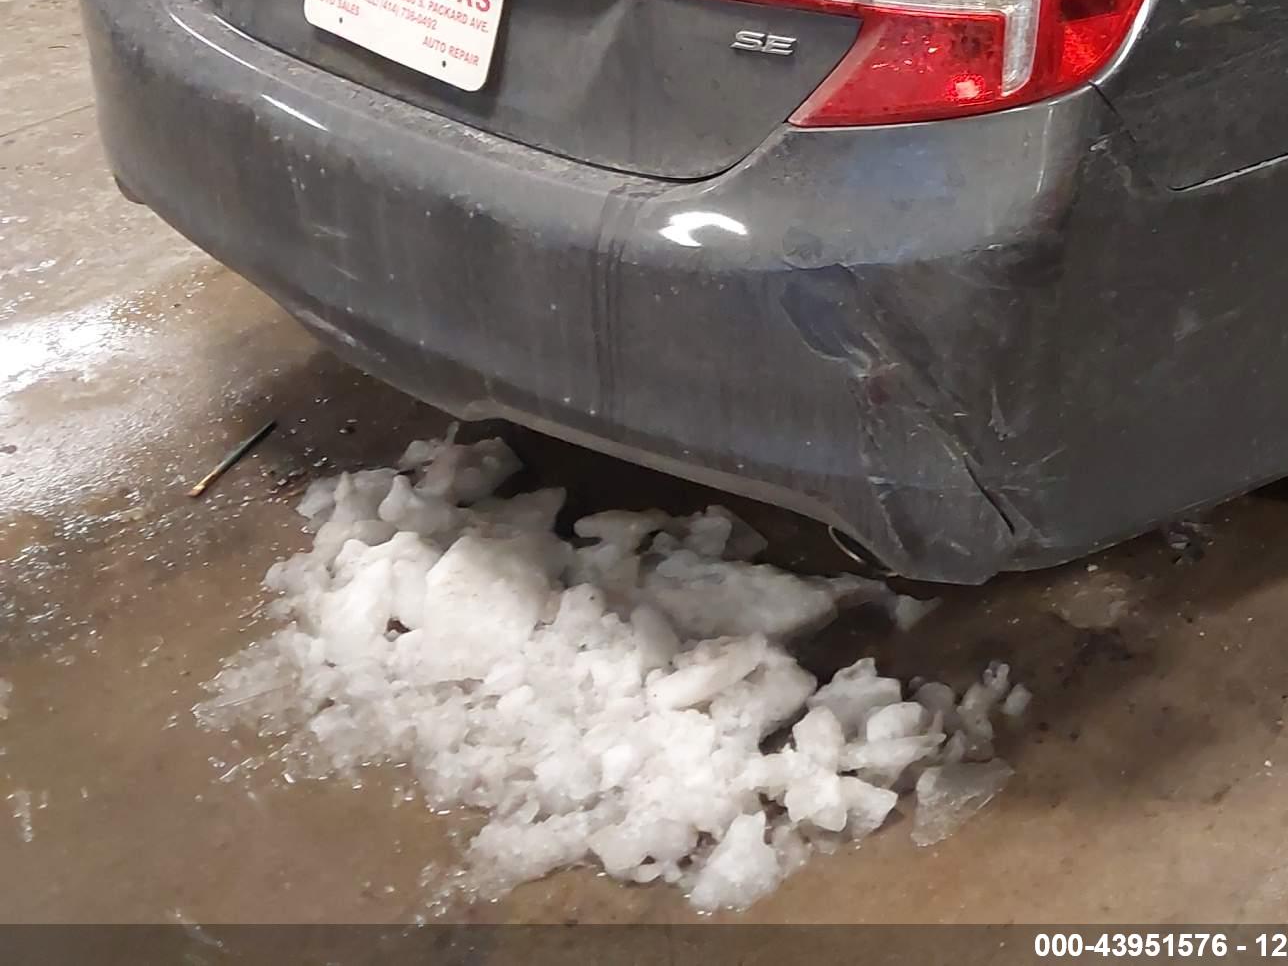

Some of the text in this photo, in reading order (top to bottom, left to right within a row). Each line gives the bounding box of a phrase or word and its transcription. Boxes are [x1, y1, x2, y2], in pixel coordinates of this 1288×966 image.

[428, 0, 469, 26] PACKARD
[470, 16, 489, 34] AVE.
[422, 35, 480, 67] AUTO REPAIR
[729, 30, 797, 56] SE
